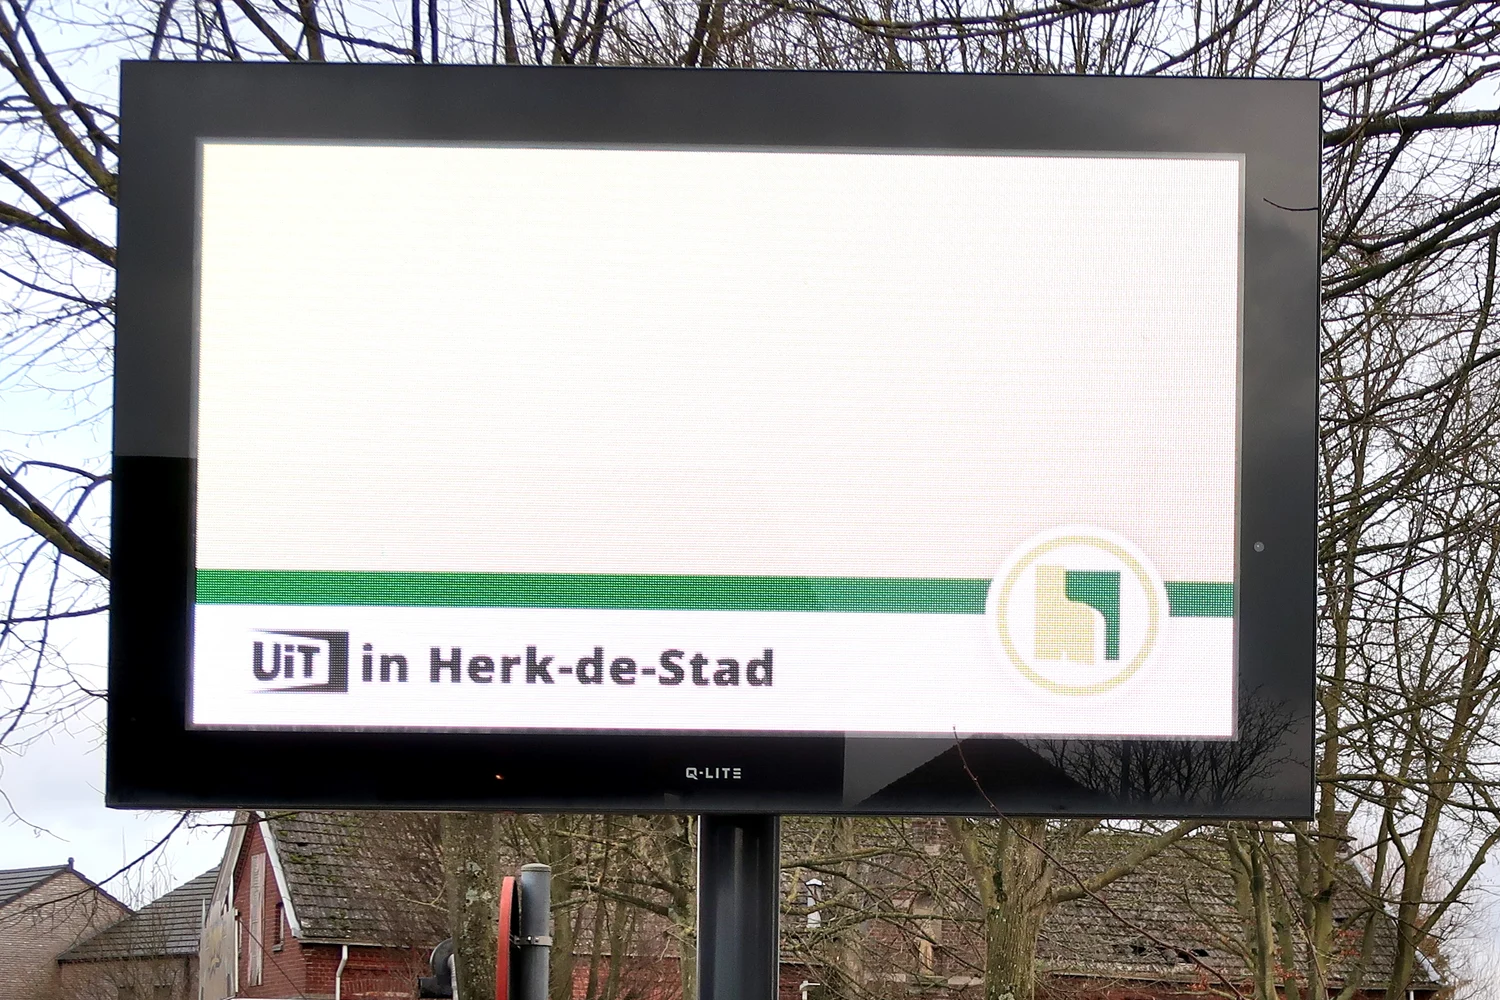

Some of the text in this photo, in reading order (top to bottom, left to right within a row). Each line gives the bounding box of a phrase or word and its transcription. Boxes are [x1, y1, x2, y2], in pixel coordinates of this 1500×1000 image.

[361, 642, 409, 684] in
[429, 644, 774, 688] Herk-de-Stad
[685, 767, 742, 781] Q-LITE
